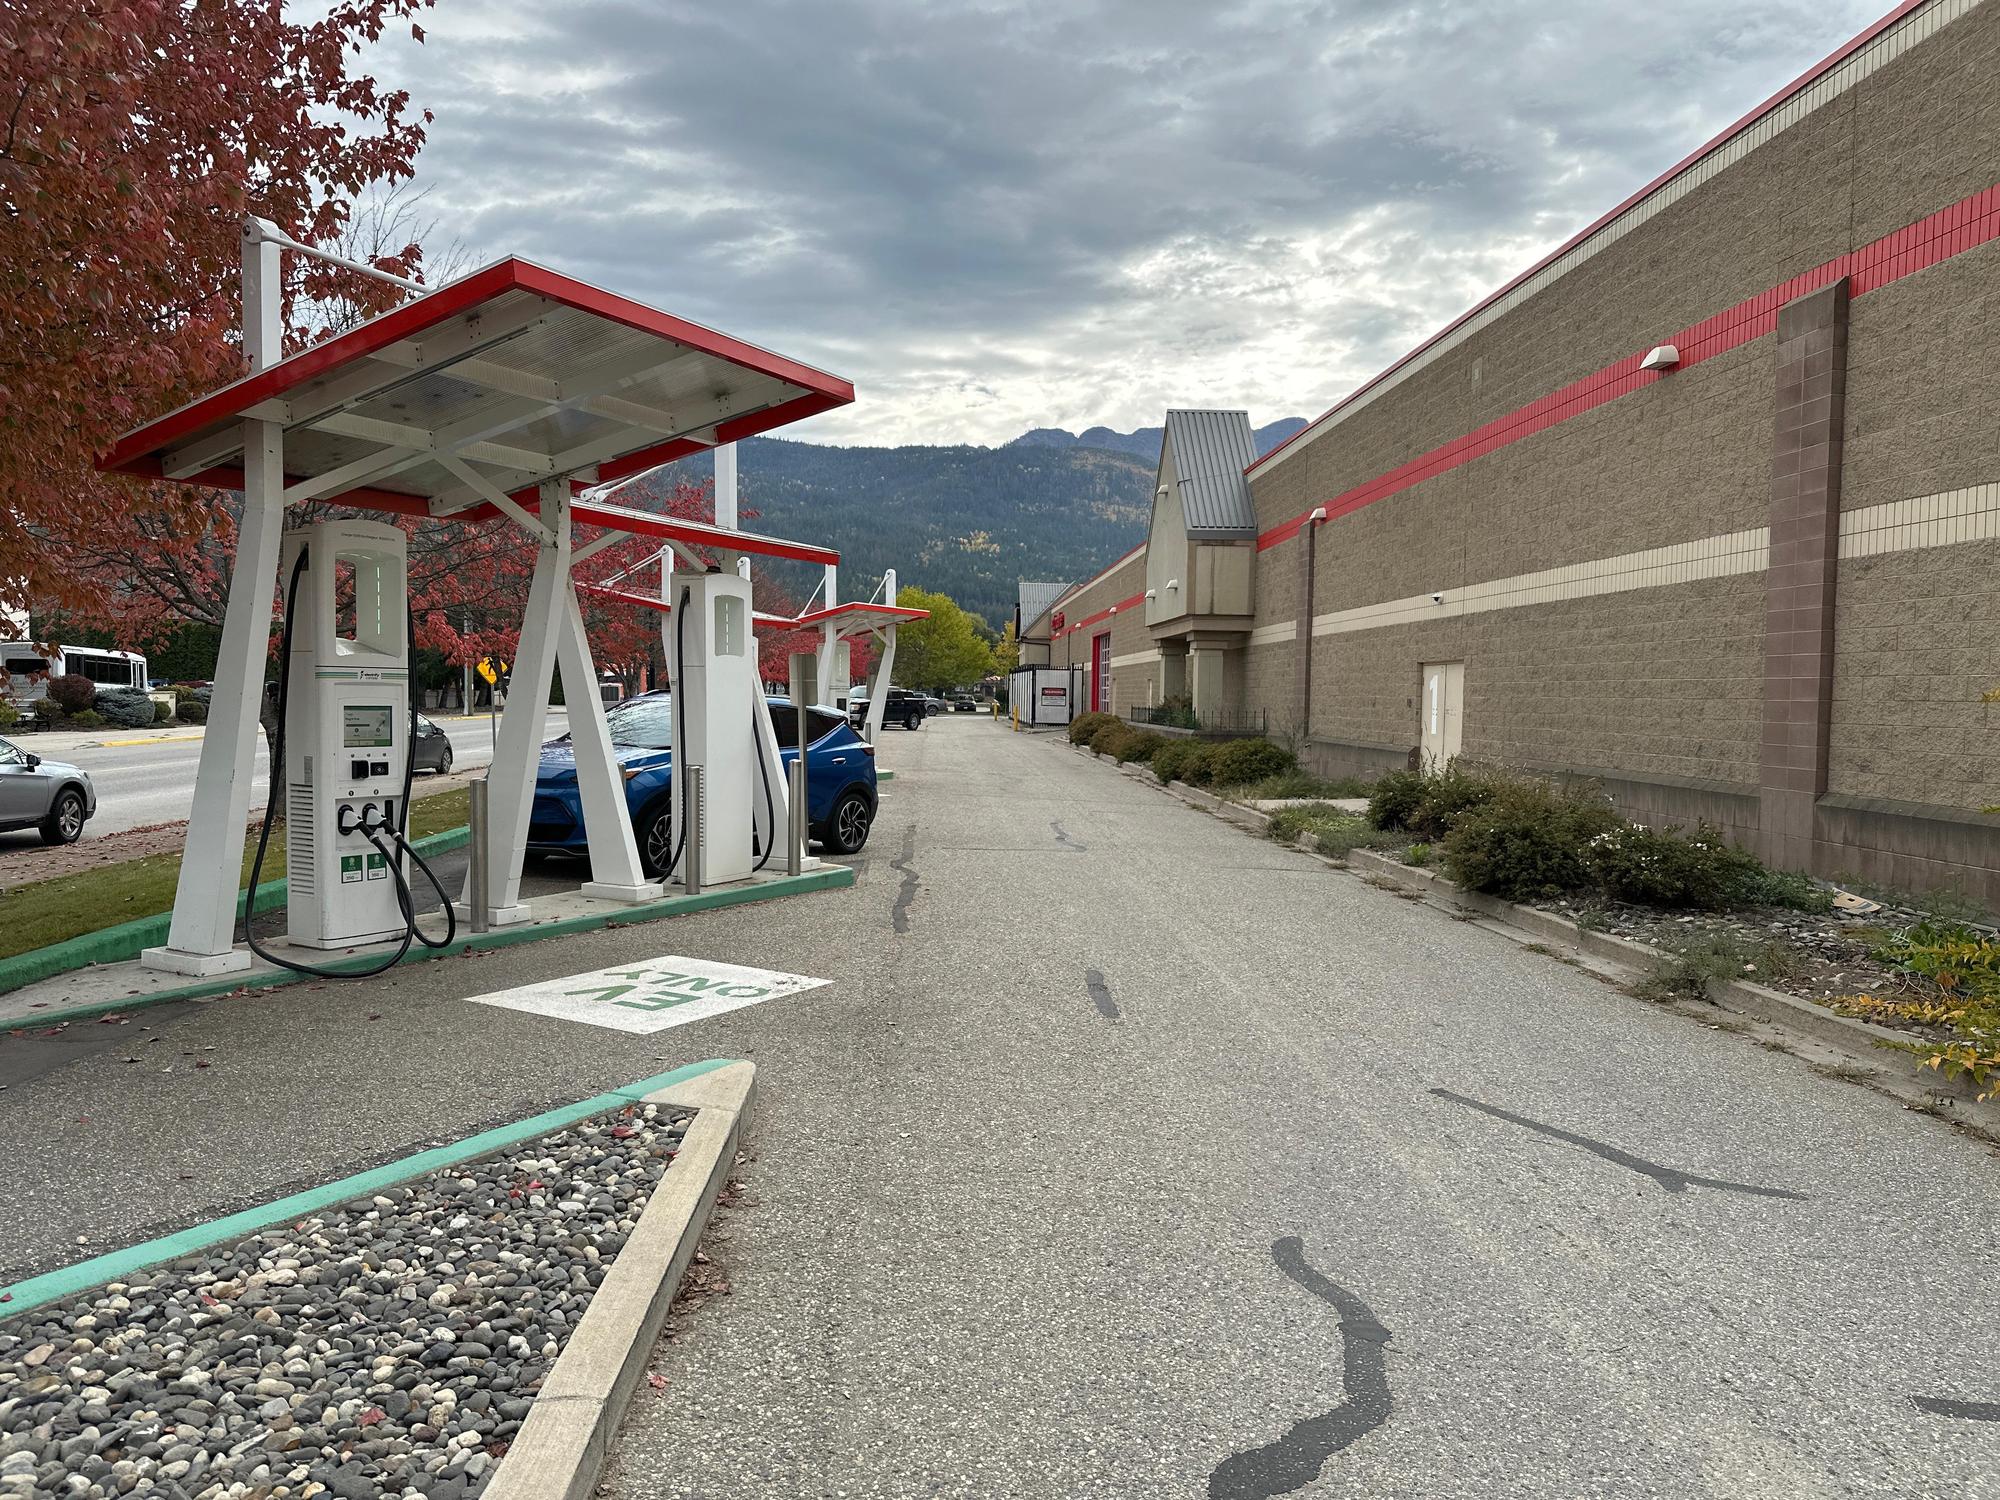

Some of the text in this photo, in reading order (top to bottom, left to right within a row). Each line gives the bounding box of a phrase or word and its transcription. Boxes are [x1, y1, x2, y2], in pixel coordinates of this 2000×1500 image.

[1430, 675, 1438, 734] 1
[563, 984, 703, 1011] EV
[604, 969, 771, 998] ONLY
